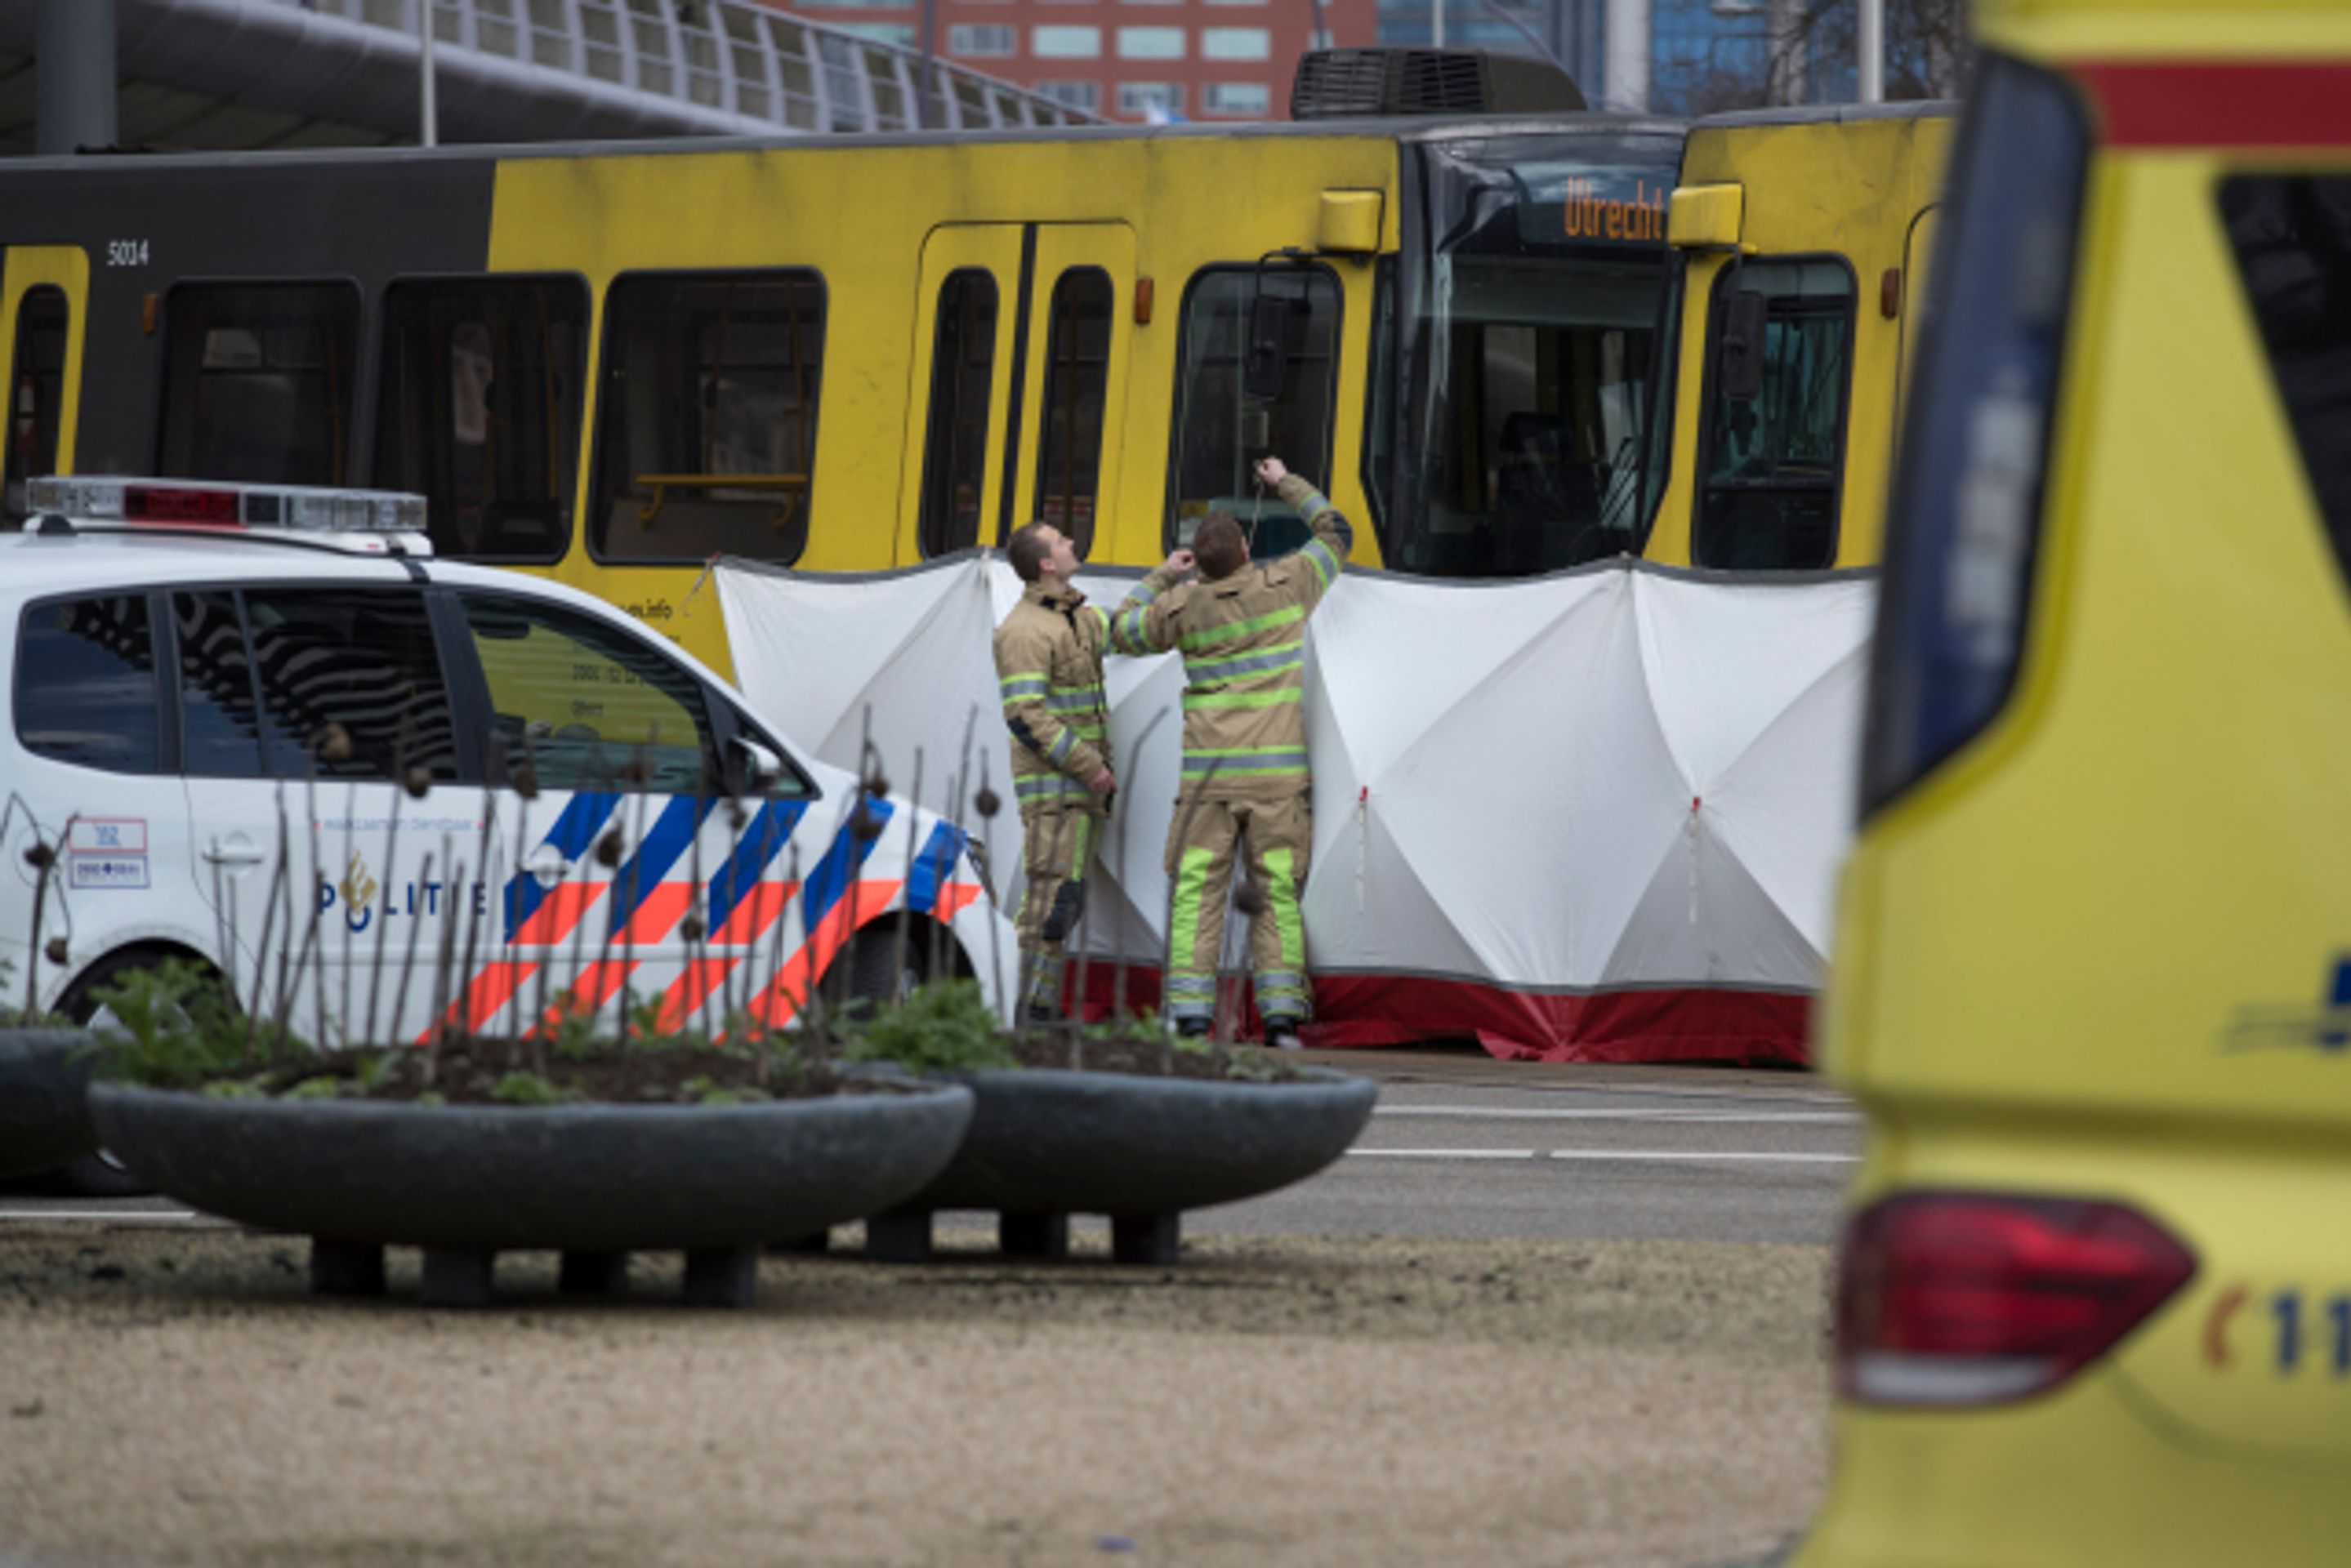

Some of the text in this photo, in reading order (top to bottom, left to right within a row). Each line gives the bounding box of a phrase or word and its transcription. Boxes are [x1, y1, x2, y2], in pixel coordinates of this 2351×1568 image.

[1564, 176, 1662, 240] Utrecht
[106, 238, 149, 265] 5014
[315, 881, 487, 933] POLITIE
